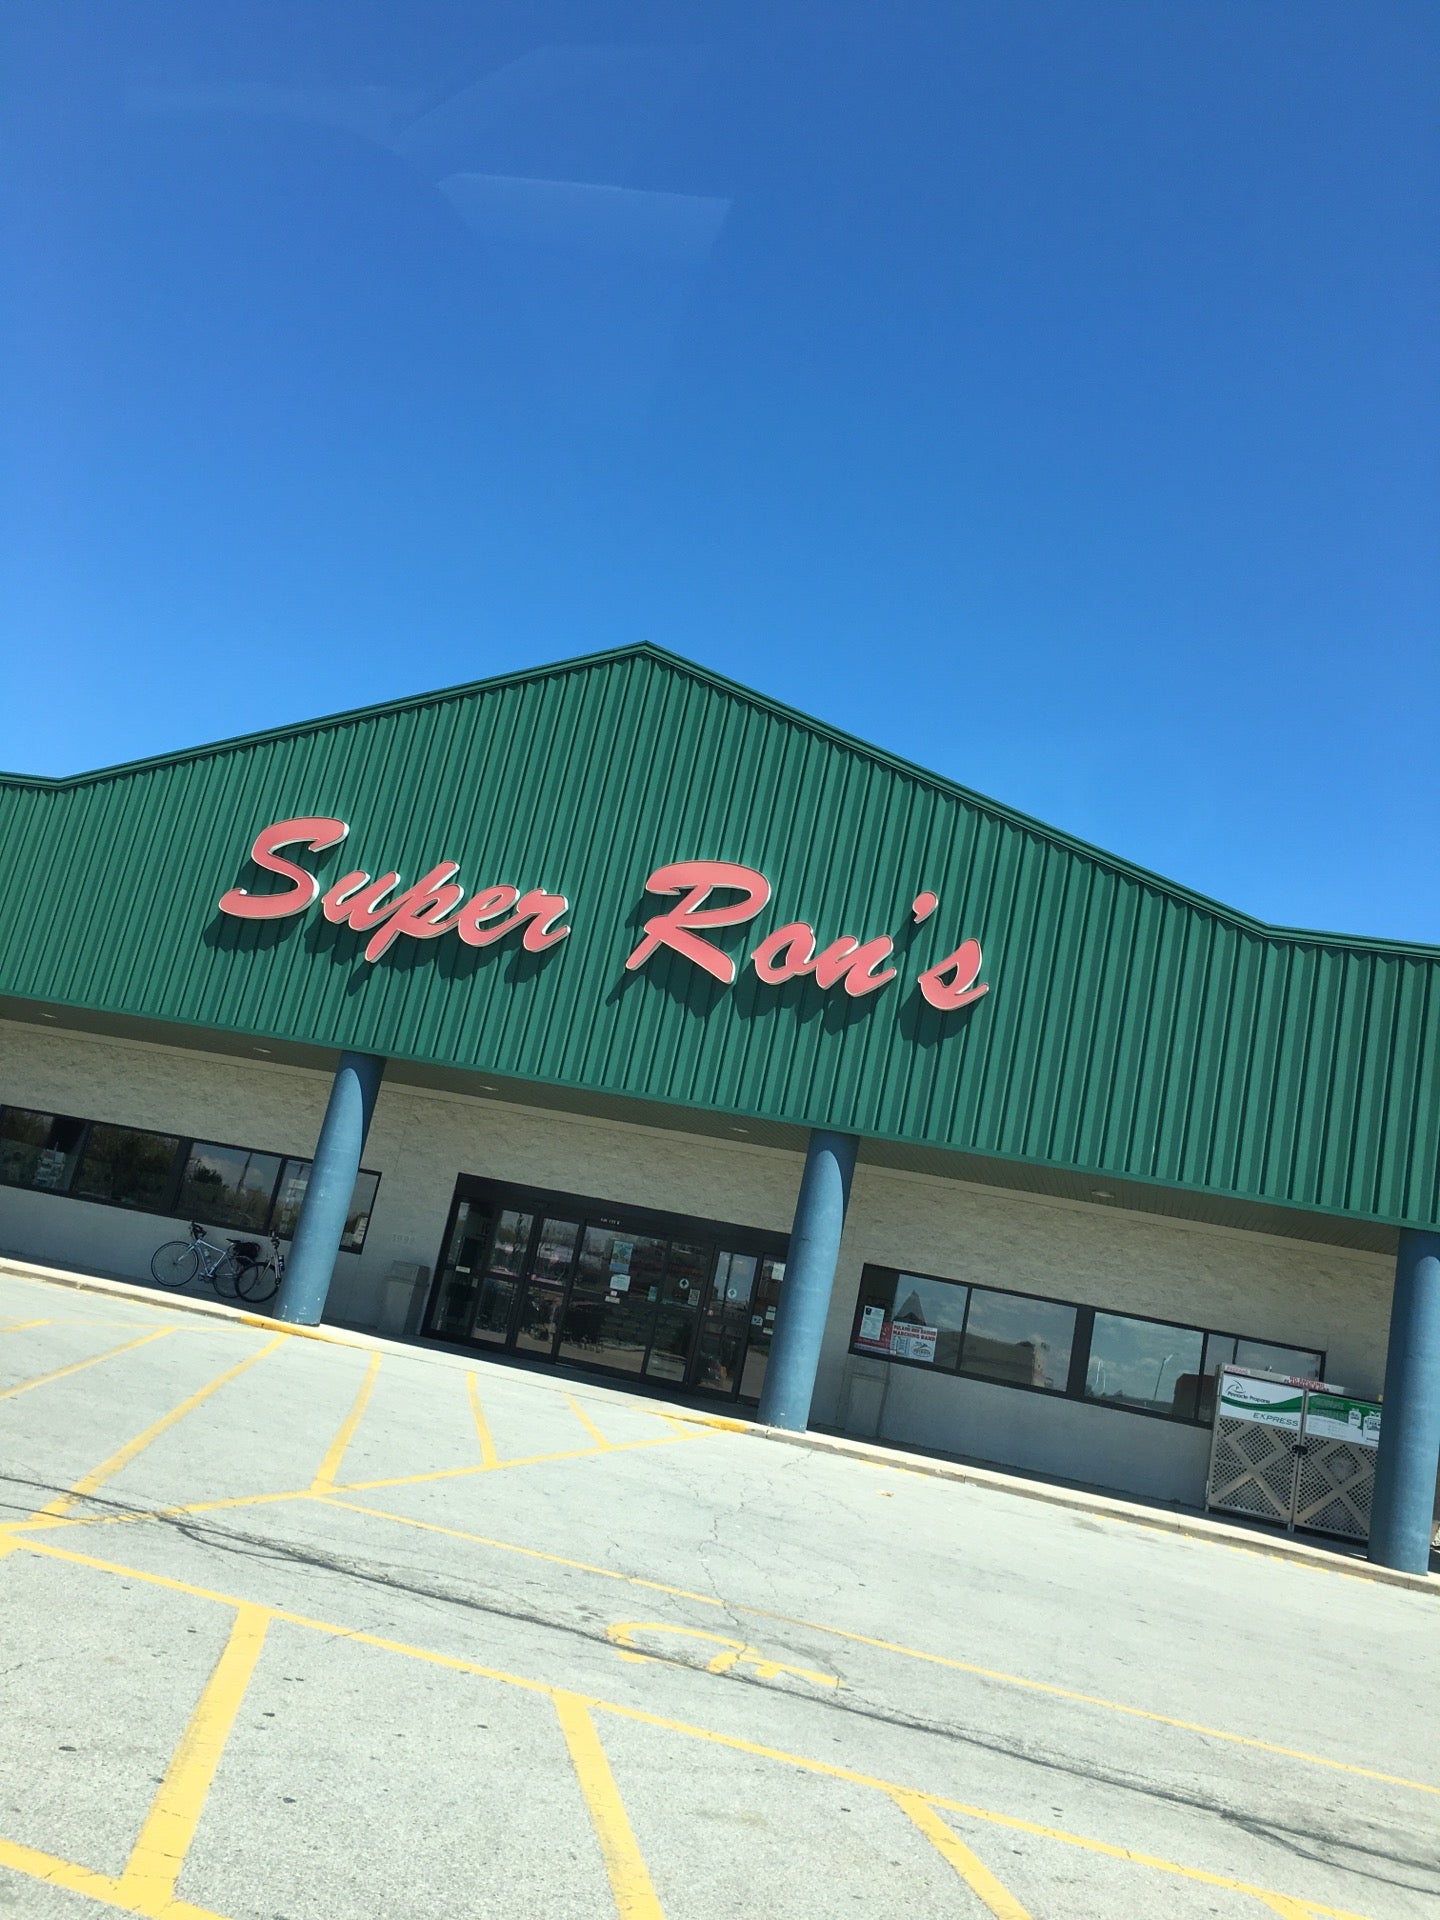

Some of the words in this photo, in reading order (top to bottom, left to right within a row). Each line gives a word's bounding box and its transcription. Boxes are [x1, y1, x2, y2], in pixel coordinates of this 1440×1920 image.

[219, 816, 570, 963] Super
[625, 860, 990, 1011] Ron's
[1253, 1412, 1299, 1427] EXPRESS
